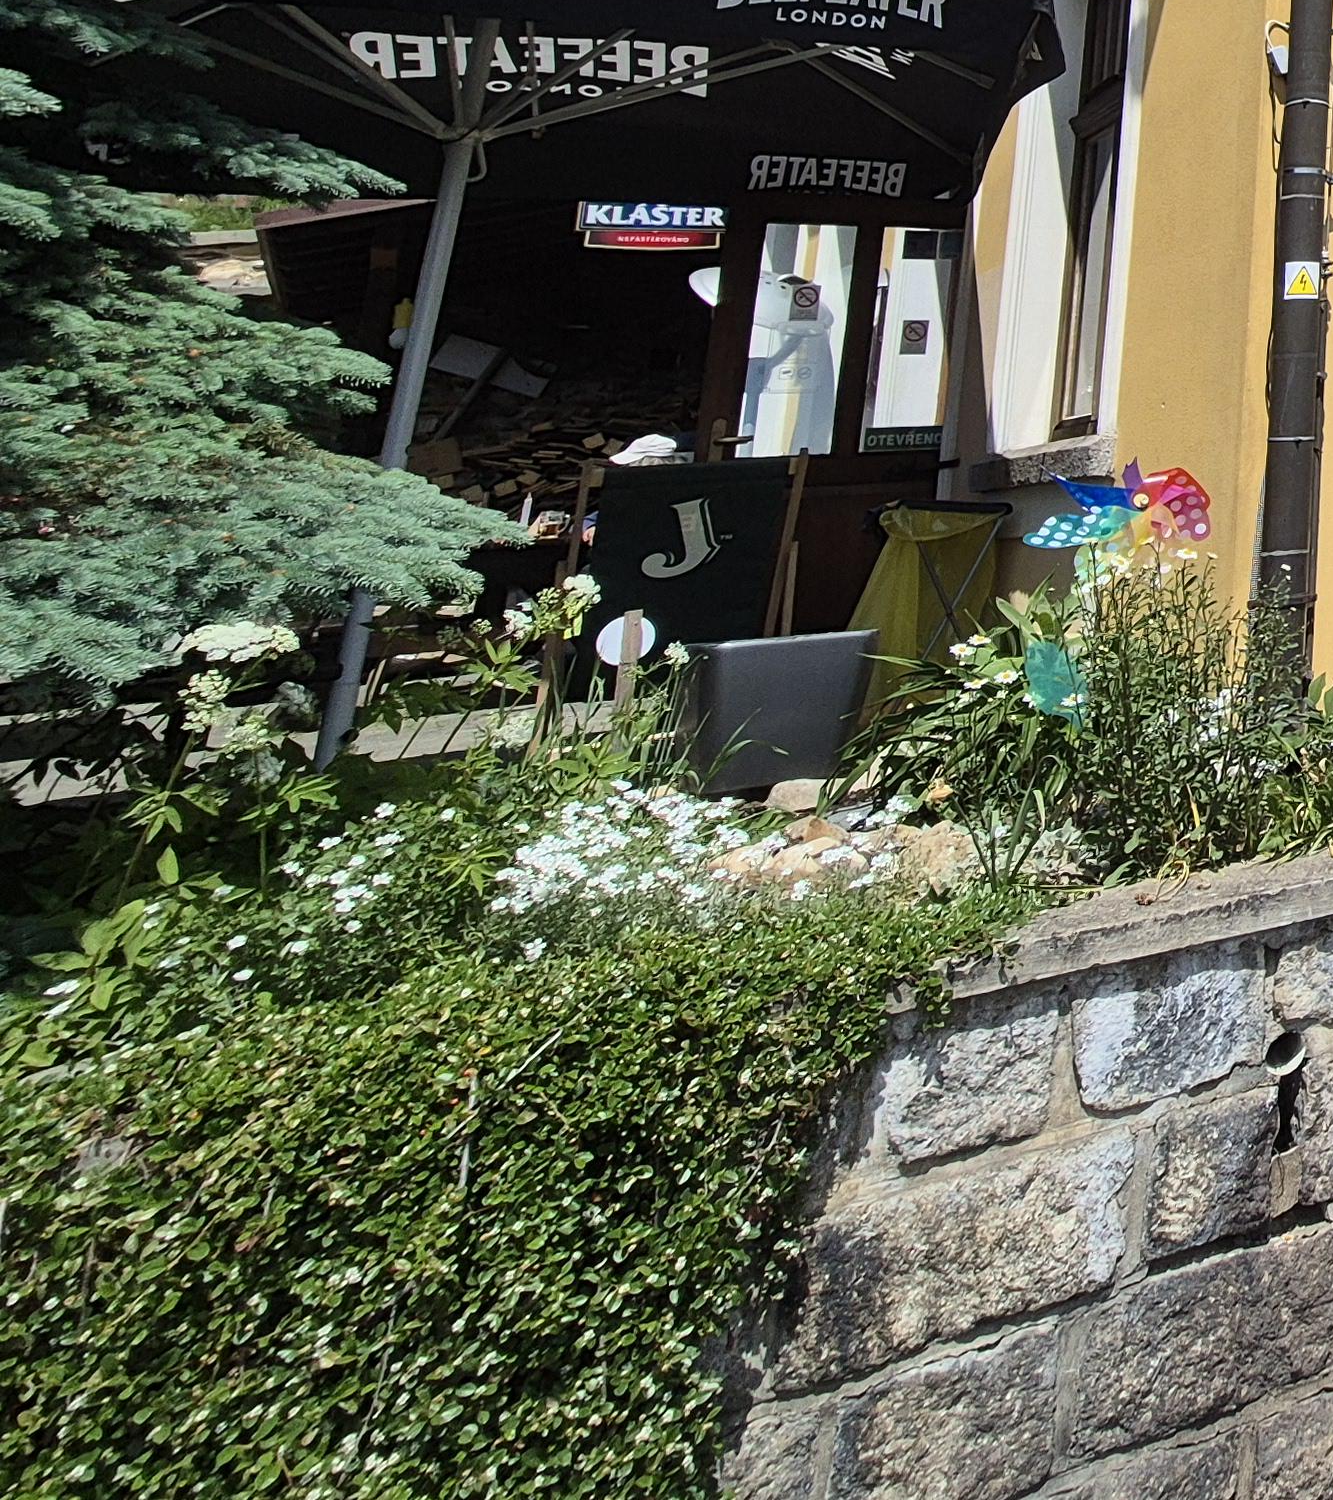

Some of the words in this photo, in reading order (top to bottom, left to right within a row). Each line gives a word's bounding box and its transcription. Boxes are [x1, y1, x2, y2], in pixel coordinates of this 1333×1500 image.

[776, 7, 887, 30] LONDON
[585, 202, 725, 227] KLÁŠTER
[641, 498, 721, 579] J
